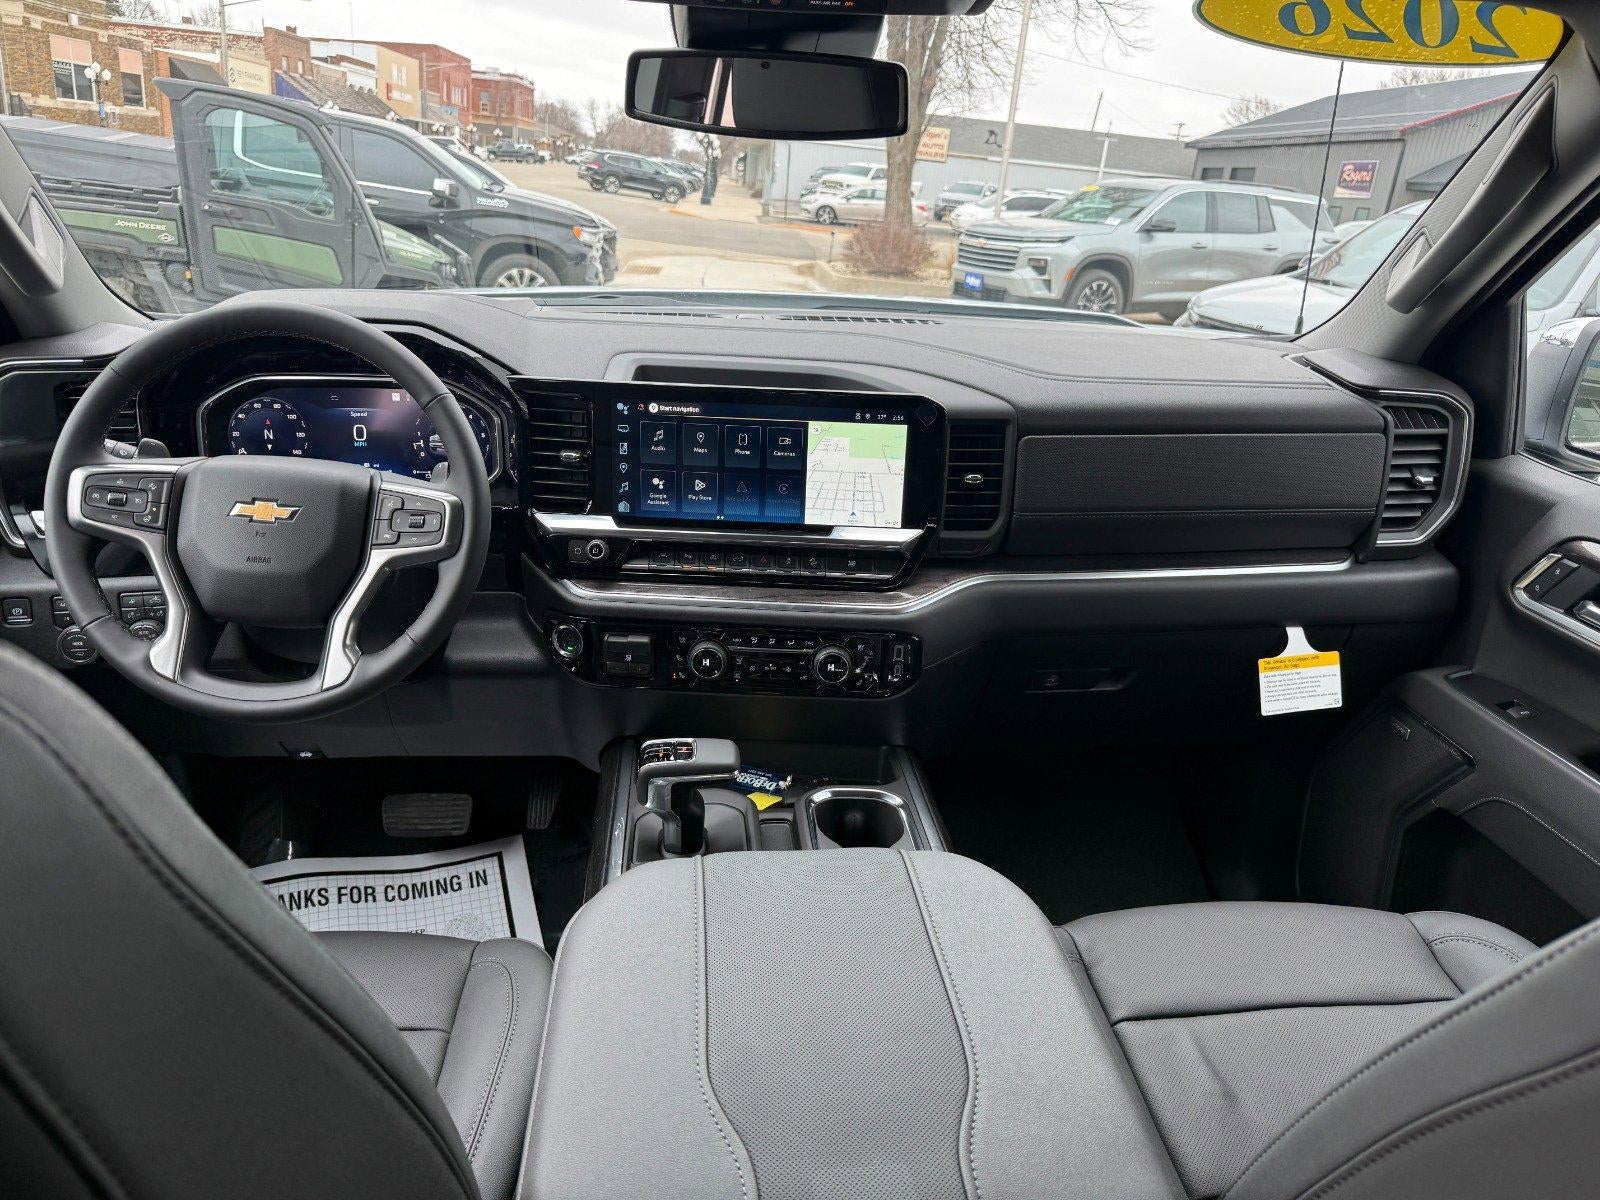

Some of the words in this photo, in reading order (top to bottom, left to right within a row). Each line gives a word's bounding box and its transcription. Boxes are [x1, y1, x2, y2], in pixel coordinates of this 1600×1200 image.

[115, 219, 138, 229] JOHN
[138, 221, 167, 231] DEERE
[672, 405, 700, 413] navigation
[264, 429, 274, 440] N
[353, 424, 367, 441] 0
[337, 885, 376, 904] FOR
[384, 875, 462, 902] COMING
[468, 869, 489, 888] IN
